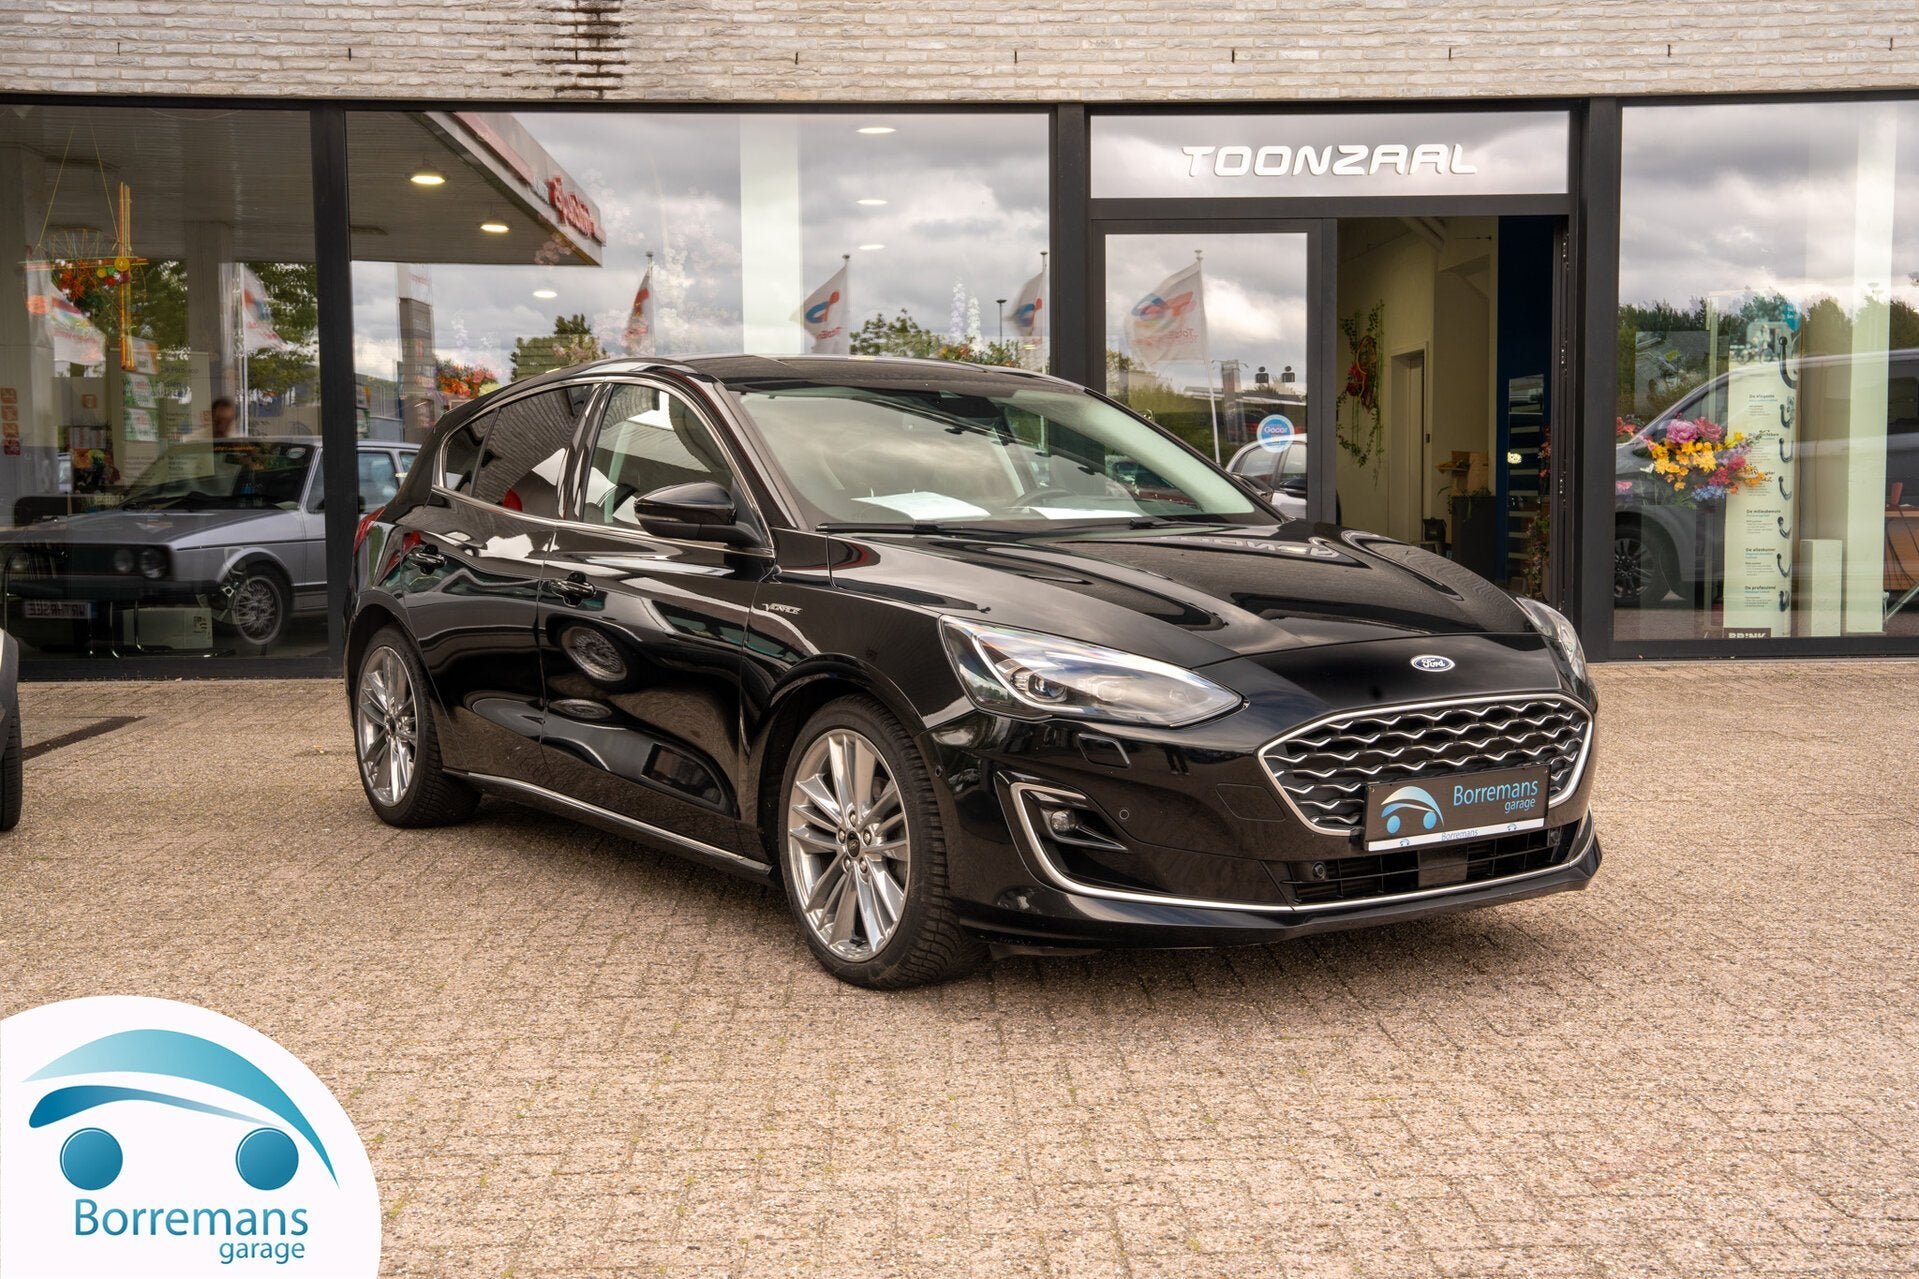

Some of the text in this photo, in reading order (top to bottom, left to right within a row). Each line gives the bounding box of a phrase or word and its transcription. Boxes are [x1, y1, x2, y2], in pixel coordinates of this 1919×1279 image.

[1182, 143, 1477, 177] TOONZAAL
[1421, 658, 1446, 668] Ford
[1453, 780, 1538, 806] Borremans
[1504, 798, 1537, 814] garage
[1441, 828, 1479, 841] Borremans
